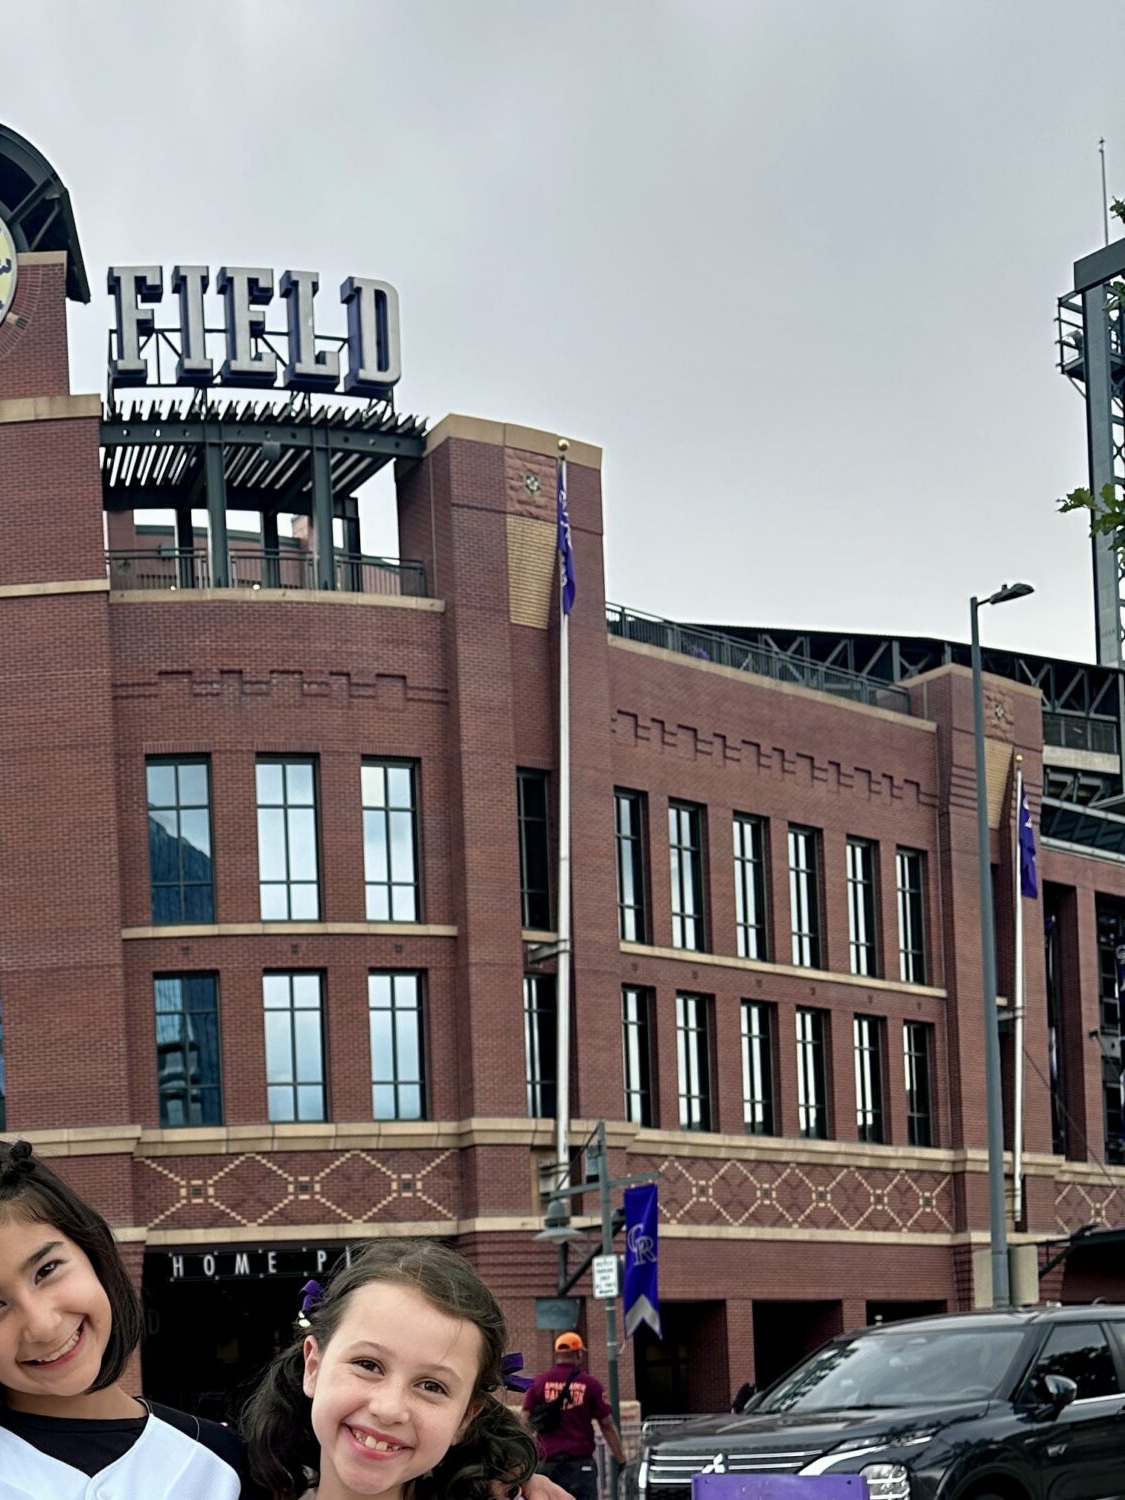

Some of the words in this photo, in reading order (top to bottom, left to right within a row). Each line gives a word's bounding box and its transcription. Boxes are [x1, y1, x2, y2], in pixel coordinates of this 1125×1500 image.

[108, 265, 402, 397] FIELD
[172, 1250, 277, 1277] HOME
[627, 1222, 656, 1266] CR
